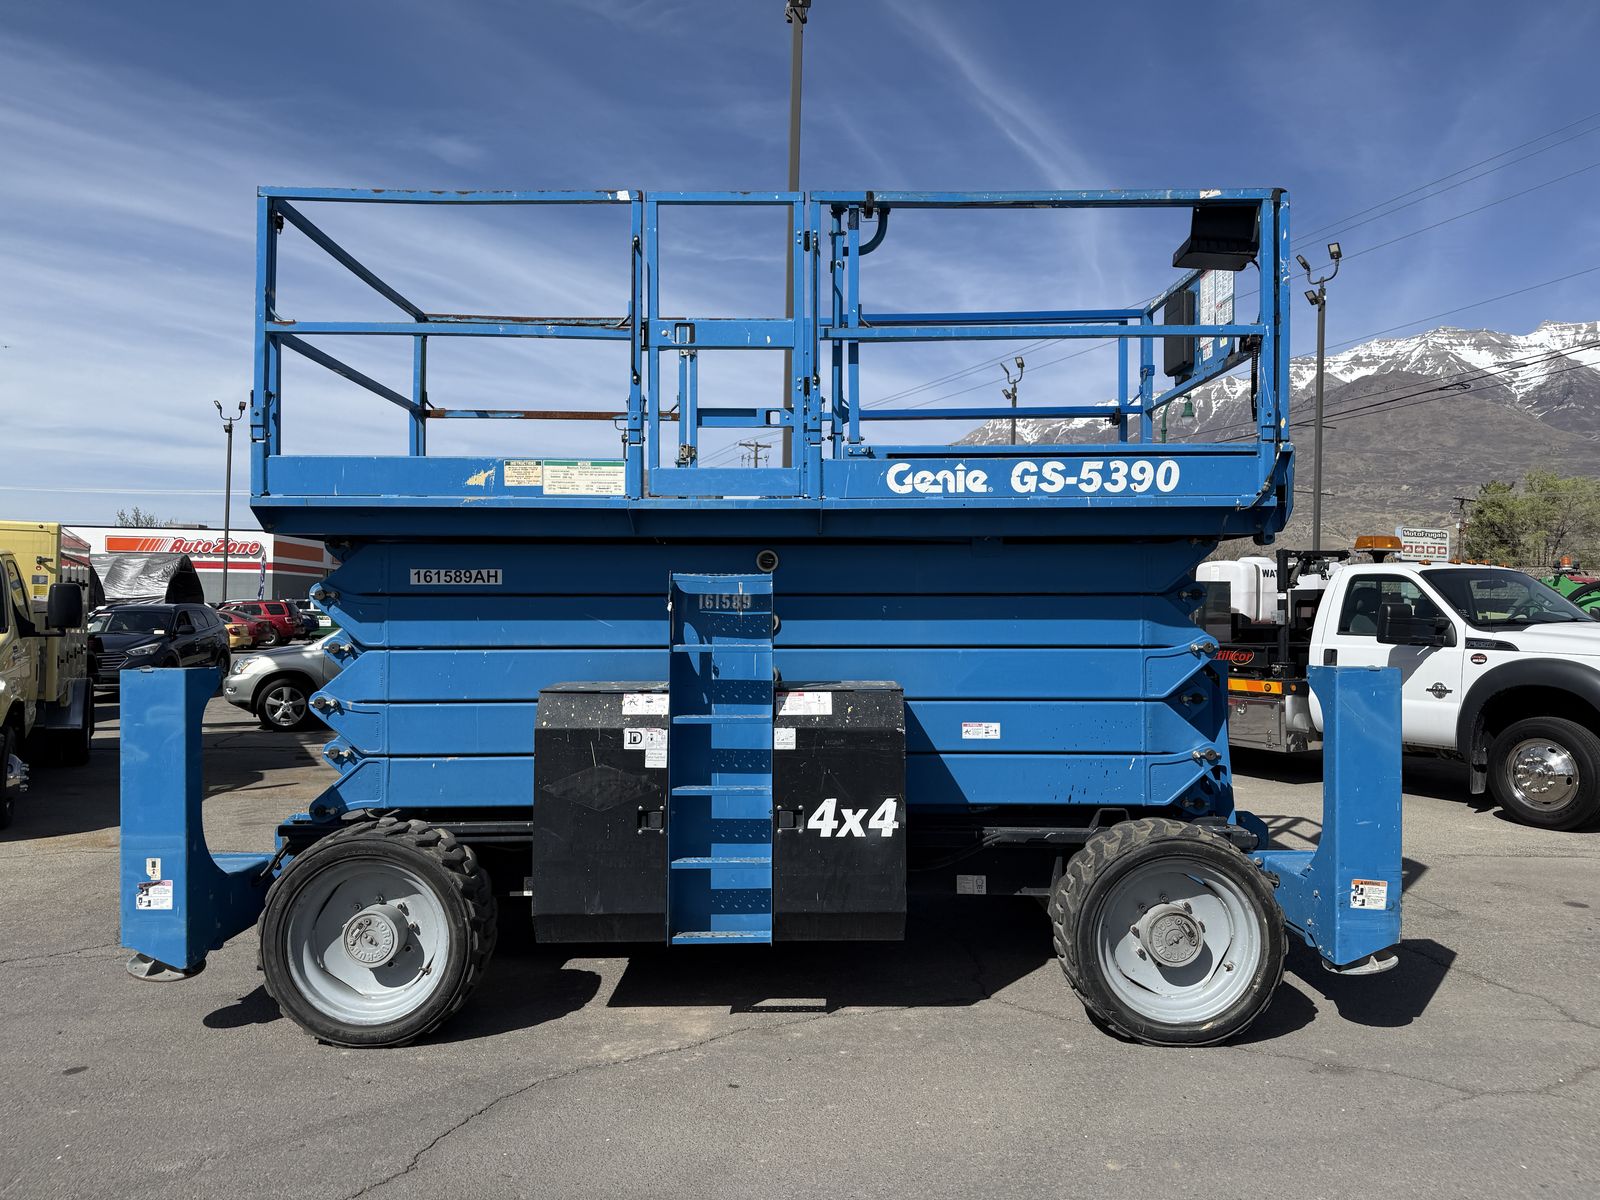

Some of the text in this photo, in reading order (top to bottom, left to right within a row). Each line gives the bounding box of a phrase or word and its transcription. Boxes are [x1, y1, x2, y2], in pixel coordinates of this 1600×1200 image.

[1010, 460, 1180, 493] GS-5390
[1403, 530, 1447, 539] MotoFrugals
[168, 538, 261, 555] AutoZone
[412, 569, 499, 584] 161589AH
[699, 594, 752, 609] 161589
[807, 798, 900, 838] 4x4
